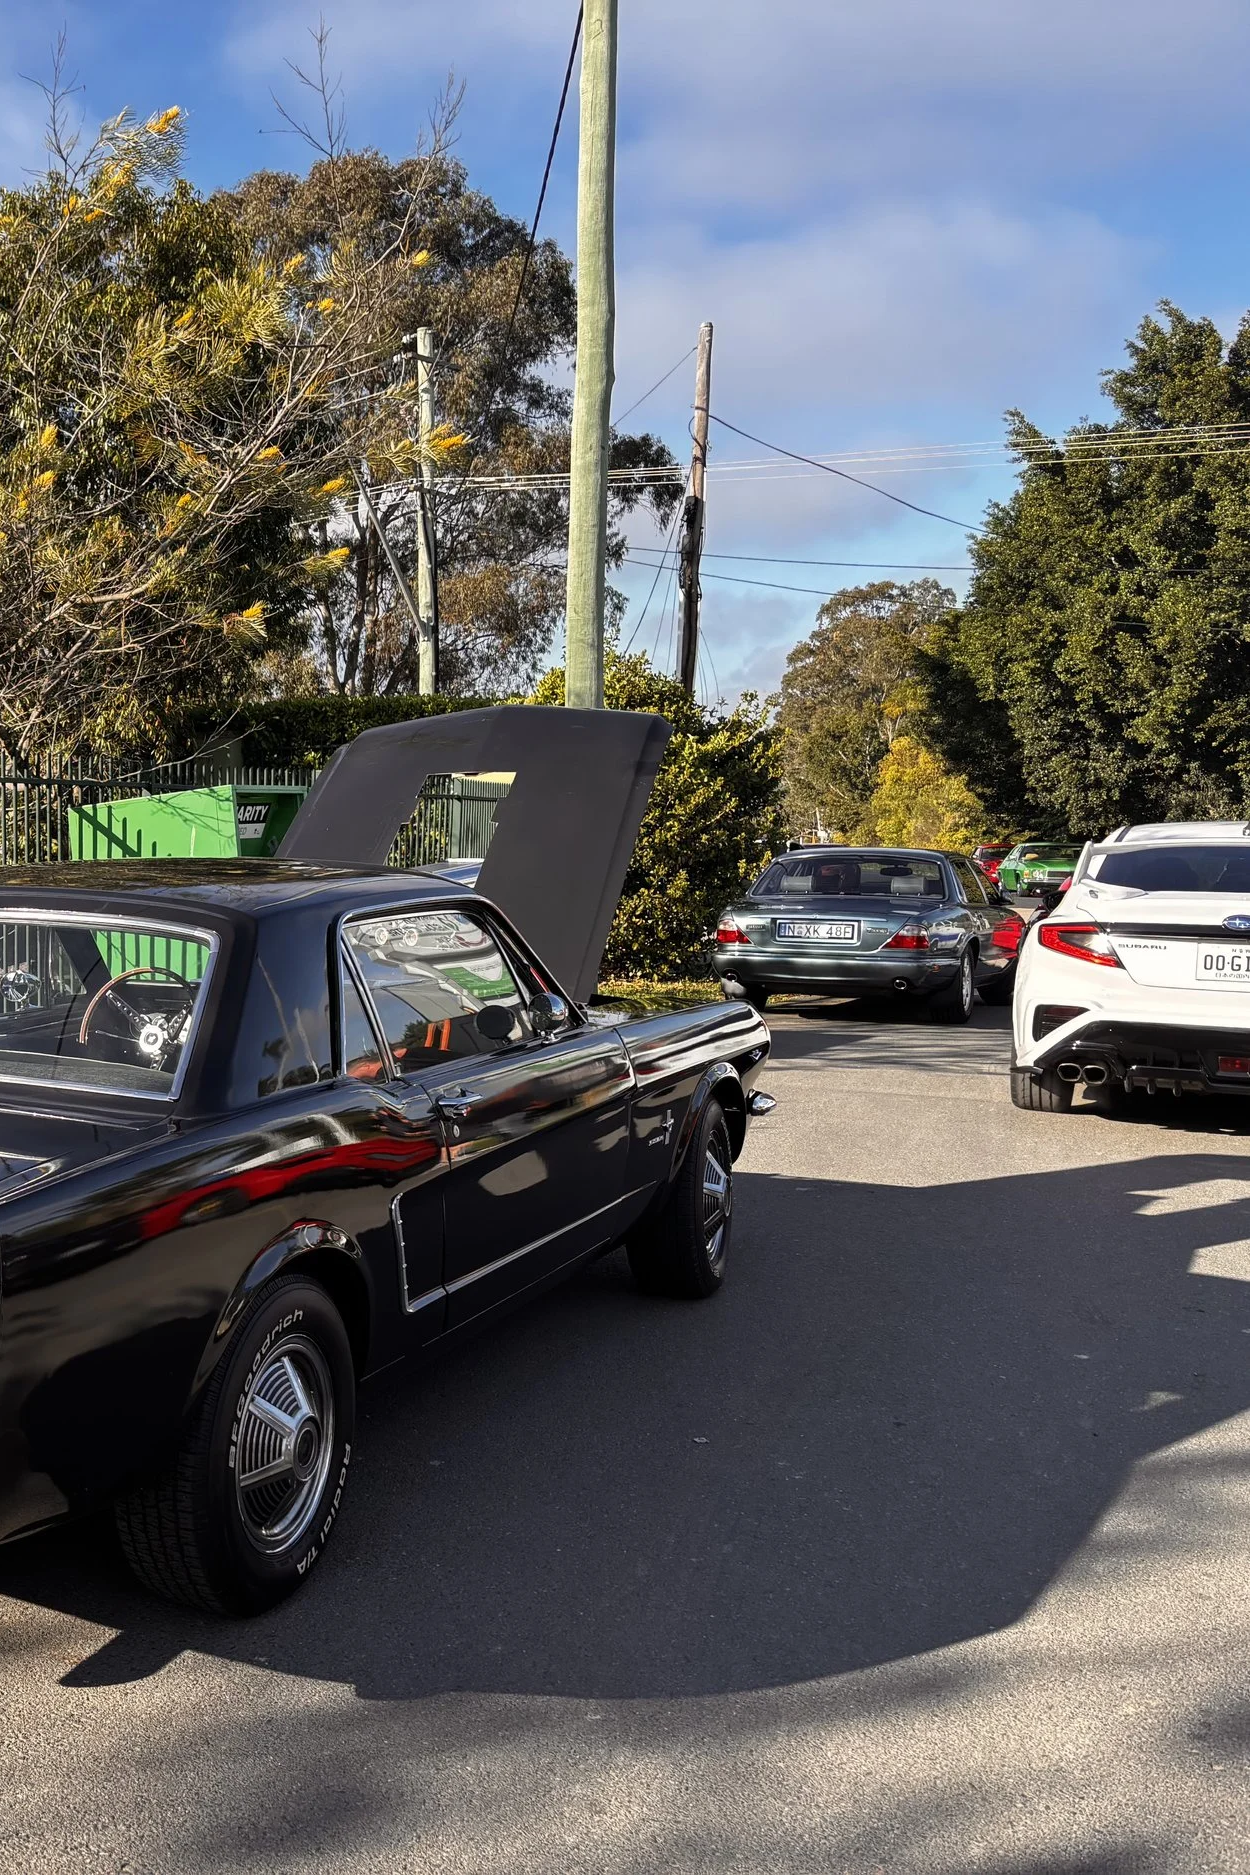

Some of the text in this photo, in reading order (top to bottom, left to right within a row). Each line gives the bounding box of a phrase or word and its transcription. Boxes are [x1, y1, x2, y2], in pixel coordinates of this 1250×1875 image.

[238, 805, 269, 821] ARITY
[229, 1309, 303, 1468] BFGoodrich
[296, 1443, 351, 1575] Radial T/A
